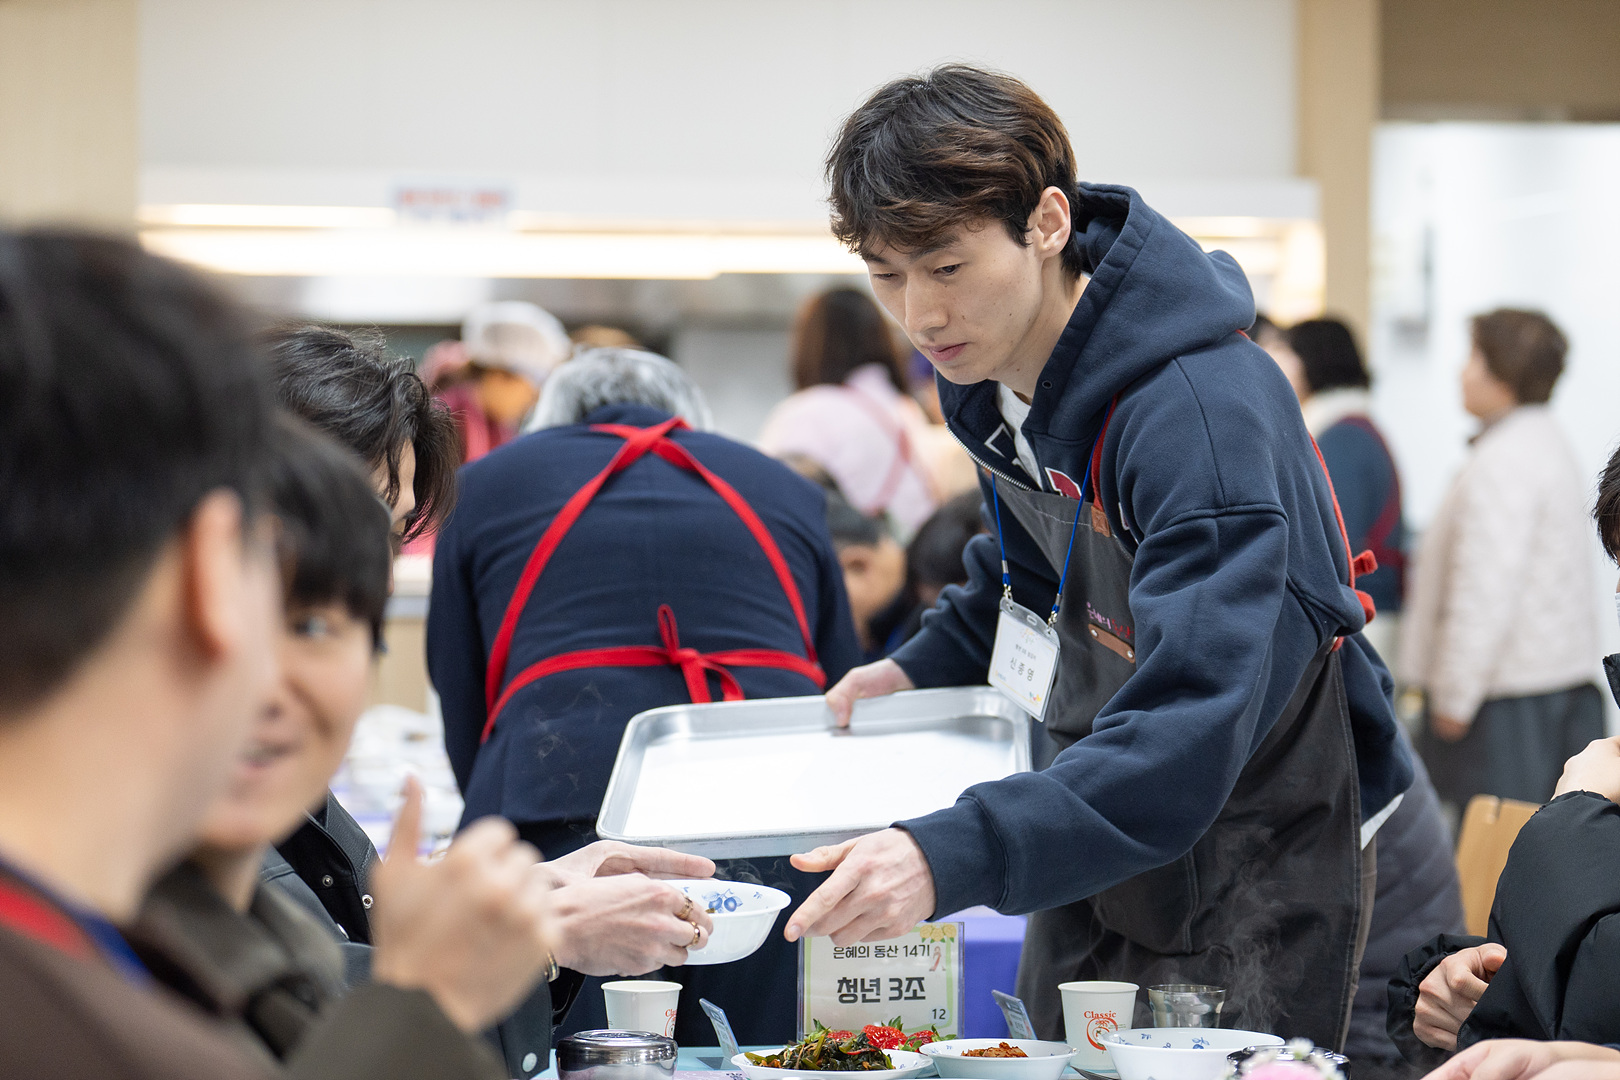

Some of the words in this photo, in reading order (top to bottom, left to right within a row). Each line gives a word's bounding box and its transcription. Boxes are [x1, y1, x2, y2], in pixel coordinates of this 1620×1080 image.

[833, 945, 870, 959] 은혜의
[874, 945, 898, 958] 동산
[902, 944, 930, 958] 14기
[837, 977, 881, 1004] 청년
[888, 976, 926, 1001] 3조
[932, 1008, 946, 1020] 12
[1083, 1010, 1117, 1019] Classic
